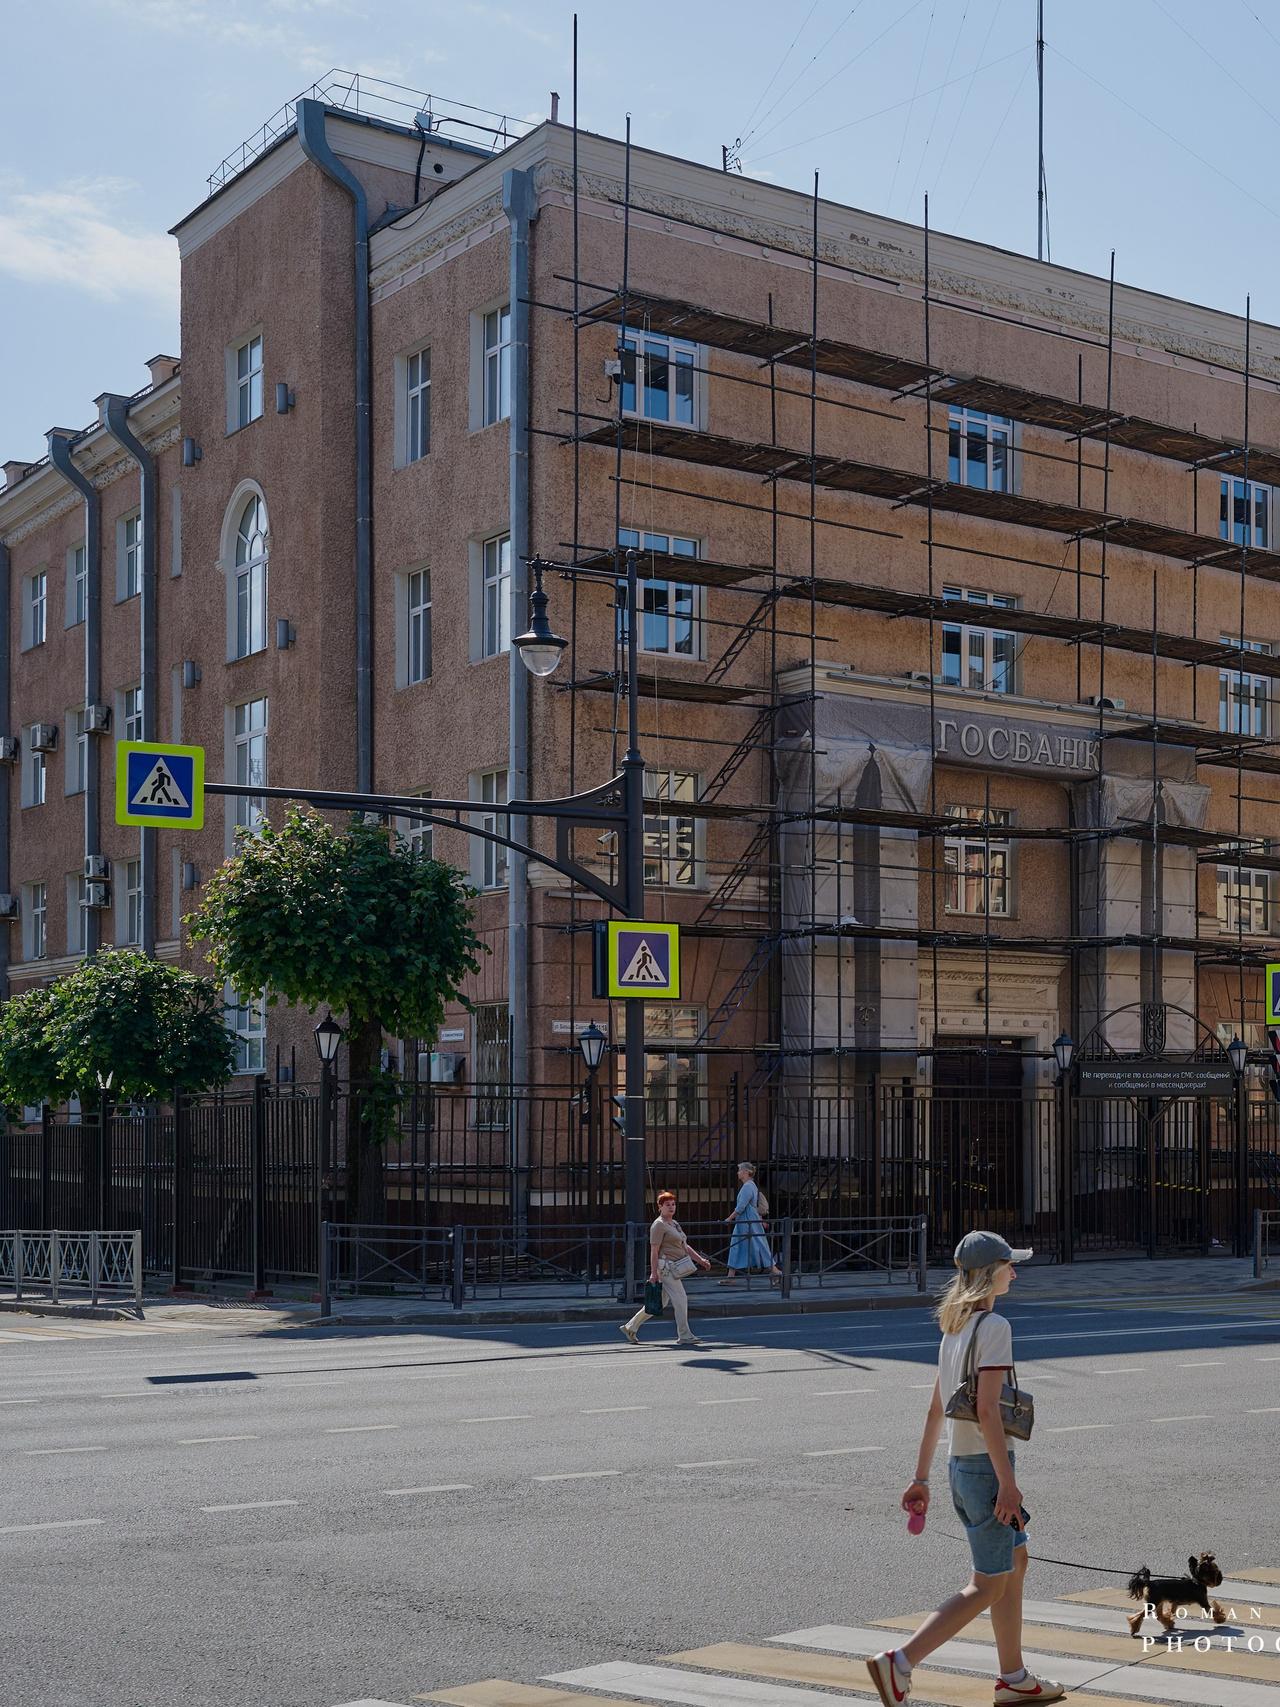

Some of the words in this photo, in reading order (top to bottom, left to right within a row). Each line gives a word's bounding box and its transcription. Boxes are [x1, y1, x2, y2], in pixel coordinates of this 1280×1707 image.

[937, 719, 1101, 772] ГОСБАНК
[1082, 1071, 1092, 1079] Не
[1093, 1072, 1132, 1080] переходите
[1113, 1080, 1150, 1089] сообщений
[1156, 1081, 1207, 1090] мессенджерах!
